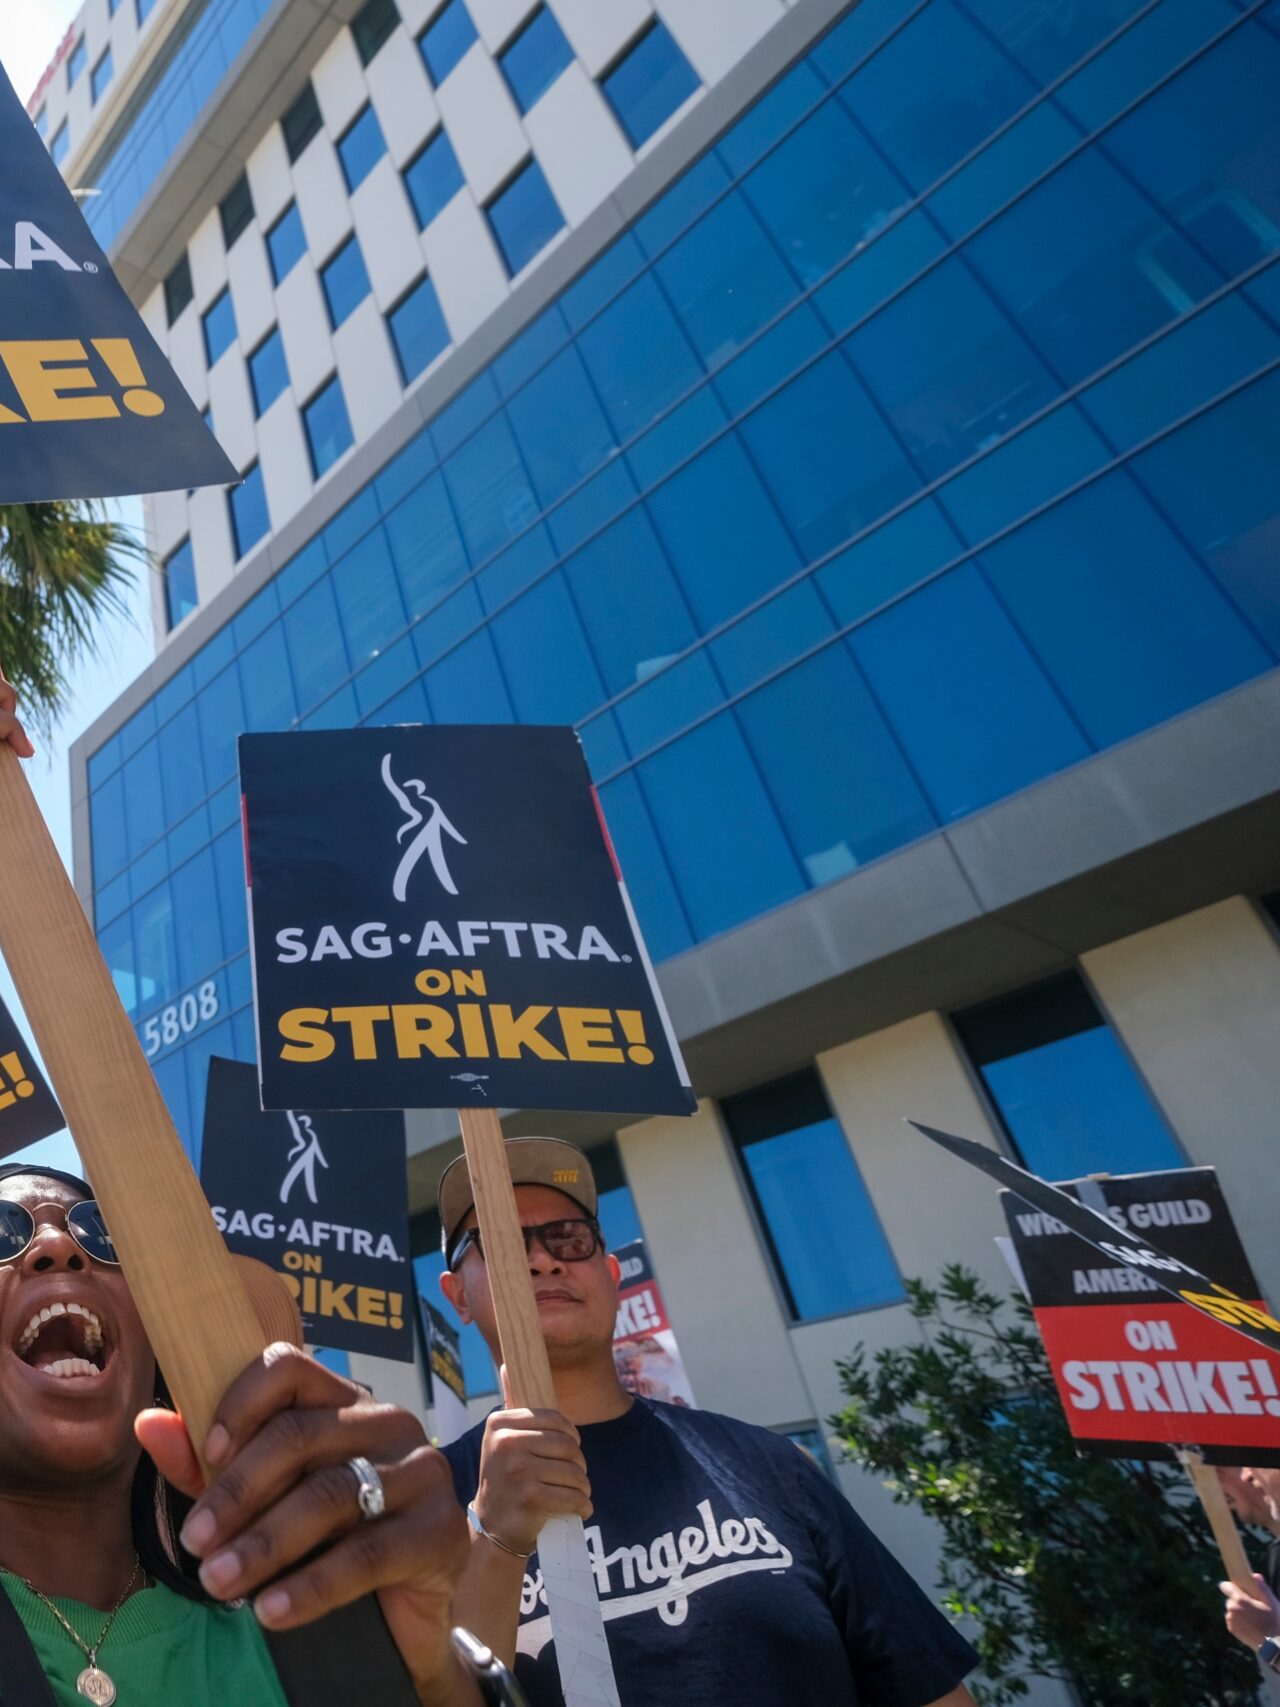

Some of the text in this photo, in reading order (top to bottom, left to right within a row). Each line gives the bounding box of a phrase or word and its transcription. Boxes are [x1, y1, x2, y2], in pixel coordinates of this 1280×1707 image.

[414, 968, 487, 997] ON
[144, 979, 219, 1057] 5808
[277, 1003, 655, 1065] STRIKE!
[1127, 1198, 1212, 1229] GUILD
[282, 1250, 322, 1275] ON
[278, 1271, 405, 1330] IKE!
[1124, 1319, 1179, 1352] ON
[1061, 1358, 1280, 1418] STRIKE!
[583, 1499, 793, 1627] Angeles
